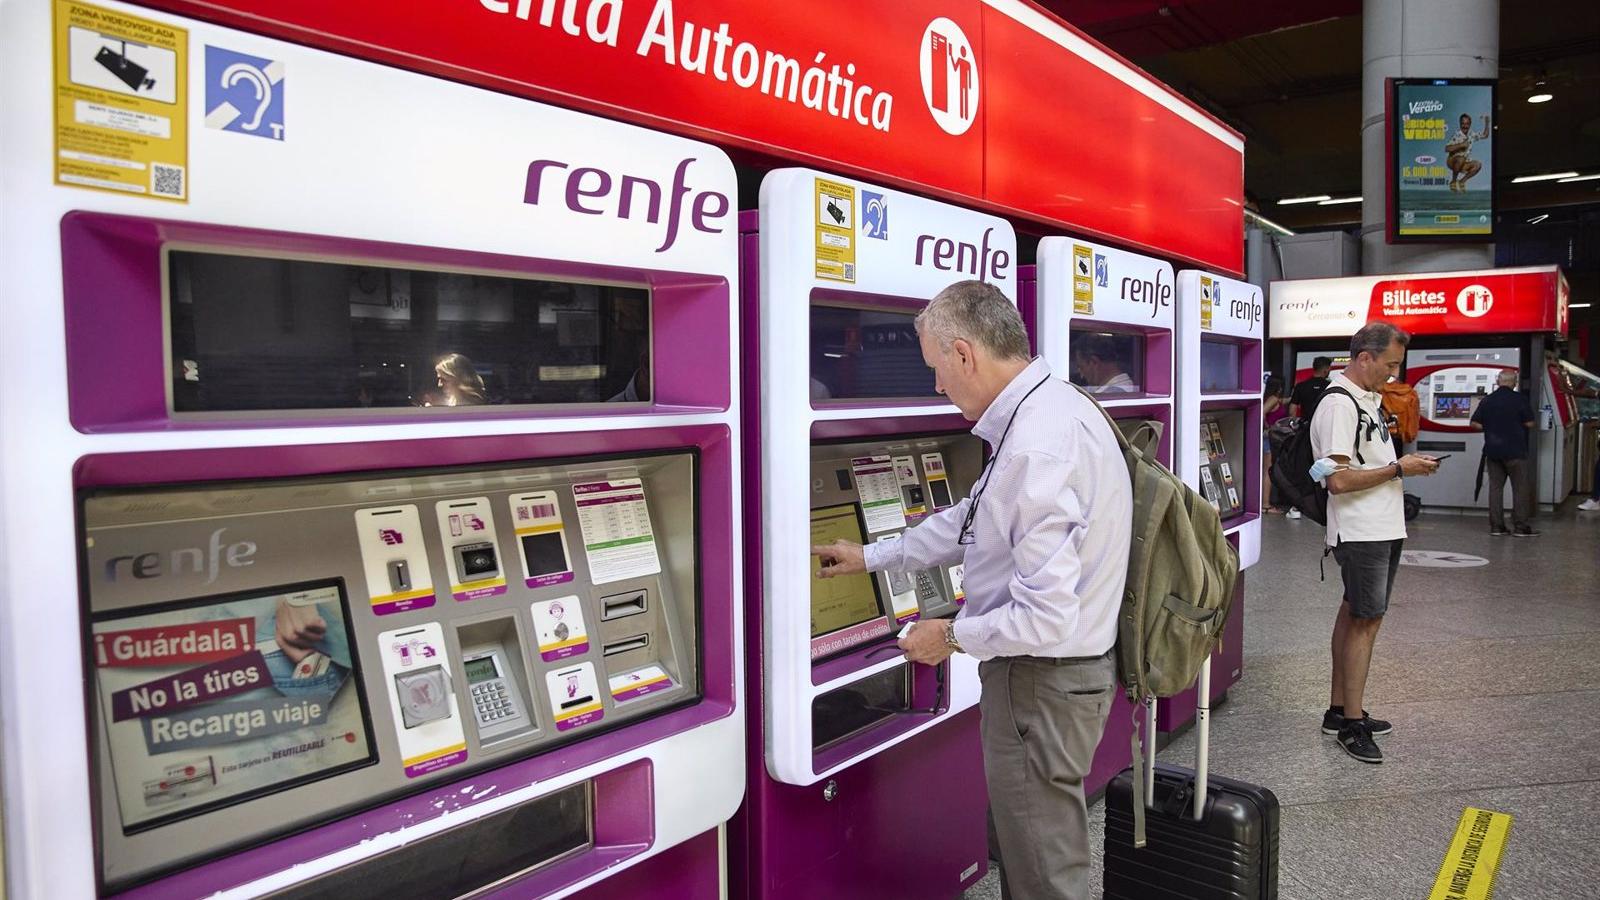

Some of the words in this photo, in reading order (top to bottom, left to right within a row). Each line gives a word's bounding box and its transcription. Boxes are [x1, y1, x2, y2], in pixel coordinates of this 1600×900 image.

[70, 6, 99, 20] ZONA
[101, 15, 176, 39] VIDEOVIGILADA
[637, 0, 893, 133] Automática
[1409, 101, 1443, 114] Verano
[523, 157, 730, 253] renfe
[914, 227, 1010, 281] renfe
[1121, 268, 1171, 319] renfe
[1230, 292, 1262, 332] renfe
[1279, 298, 1319, 312] renfe
[1383, 289, 1445, 306] Billetes
[1383, 307, 1404, 315] Venta
[1405, 306, 1447, 314] Automática
[105, 528, 257, 584] renfe
[818, 642, 831, 654] sólo
[831, 639, 842, 650] con
[842, 632, 862, 645] tarjeta
[861, 629, 870, 639] de
[129, 687, 168, 713] No
[174, 679, 199, 703] la
[203, 666, 260, 694] tires
[151, 708, 267, 744] Recarga
[271, 700, 323, 726] viaje
[271, 739, 326, 760] REUTILIZABLE
